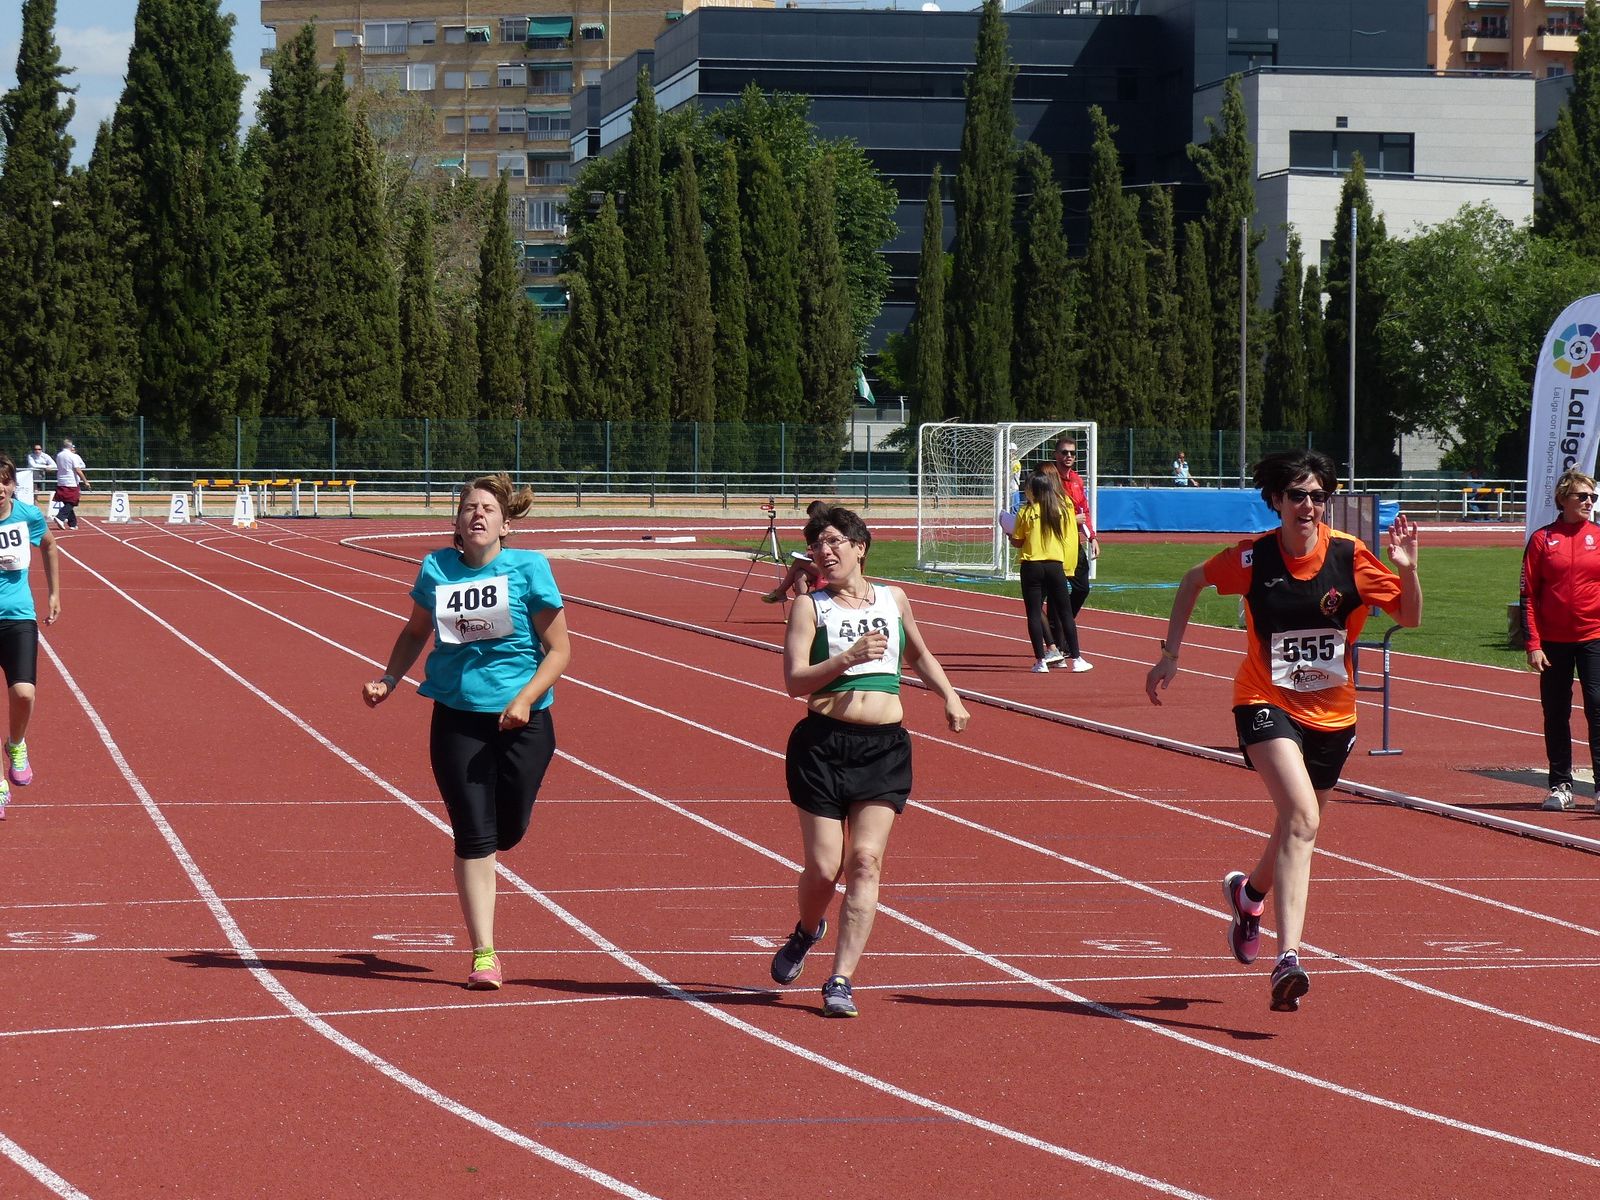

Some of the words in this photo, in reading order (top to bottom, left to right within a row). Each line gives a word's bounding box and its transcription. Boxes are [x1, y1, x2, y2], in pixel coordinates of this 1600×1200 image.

[1550, 387, 1561, 413] LaLiga
[1549, 430, 1556, 439] el
[1561, 388, 1589, 473] LaLiga
[1546, 441, 1556, 474] Deporte
[1544, 476, 1554, 507] Español
[115, 498, 124, 512] 3
[174, 500, 184, 514] 2
[241, 500, 247, 514] 1
[447, 585, 497, 612] 408
[839, 617, 889, 643] 448
[1283, 634, 1335, 662] 555
[1424, 941, 1523, 953] 2
